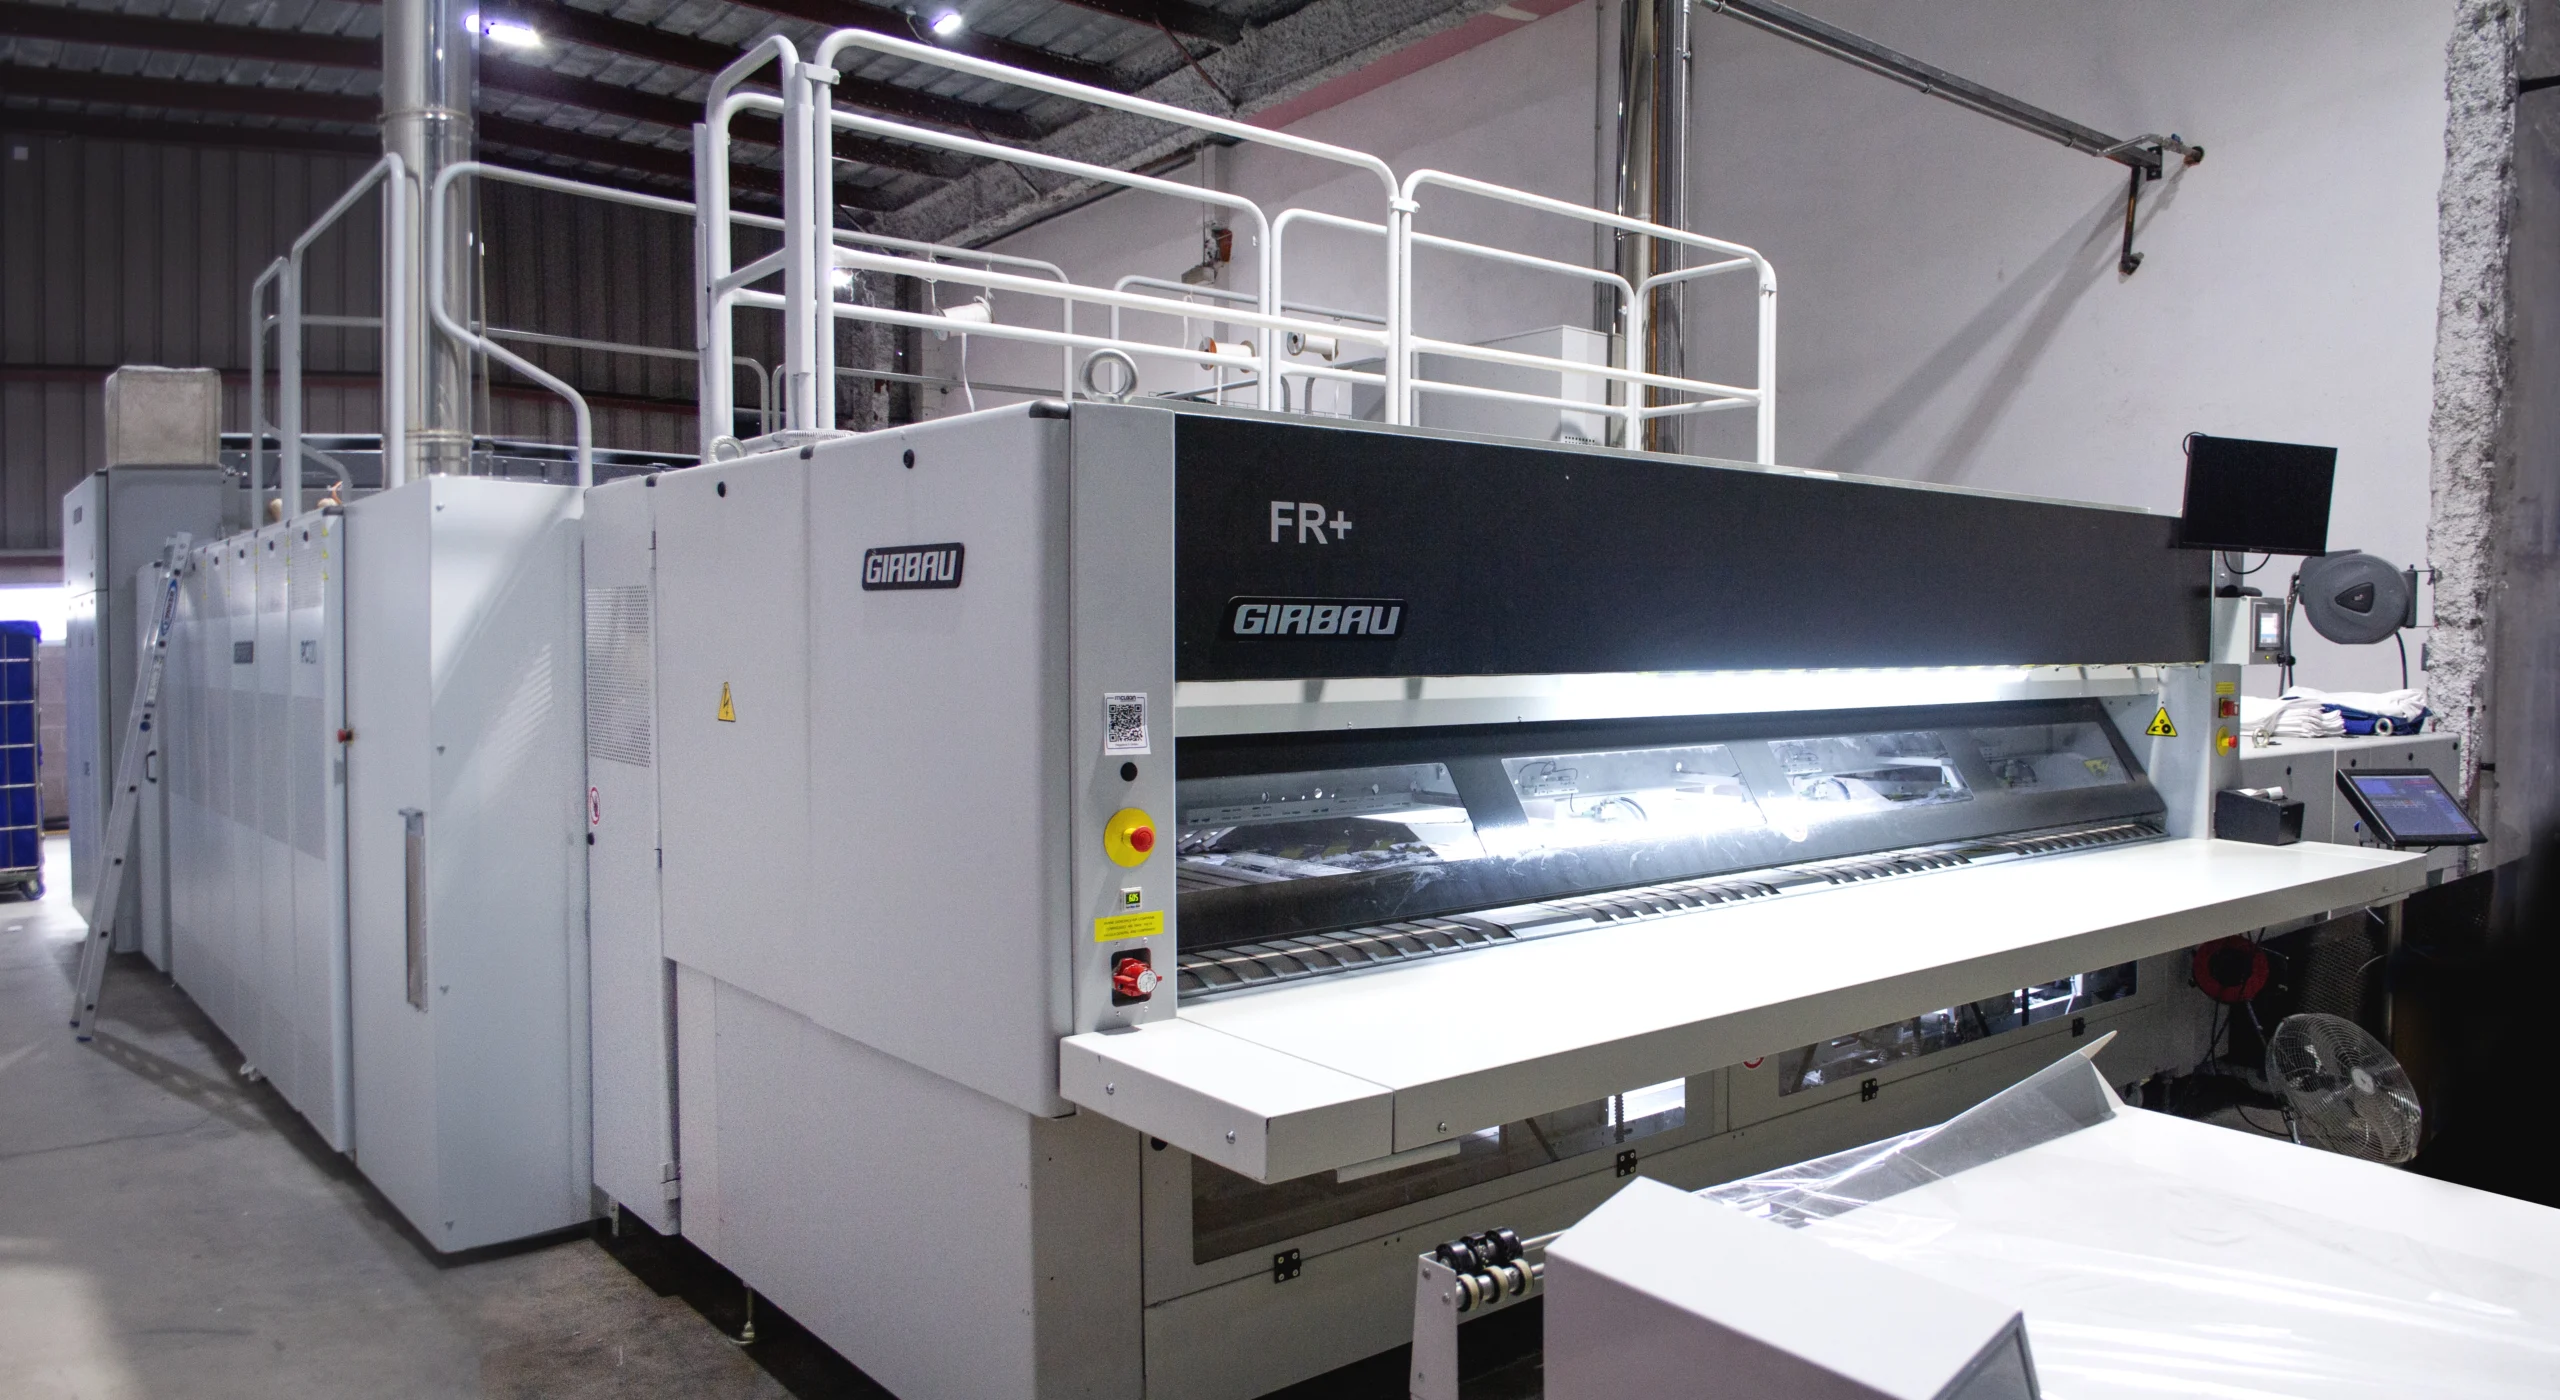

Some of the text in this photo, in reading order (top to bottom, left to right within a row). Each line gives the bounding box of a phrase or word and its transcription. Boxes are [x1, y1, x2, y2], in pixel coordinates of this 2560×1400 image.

[1271, 501, 1352, 544] FR+
[867, 550, 957, 584] GIRBAU
[1233, 604, 1400, 635] GIRBAU
